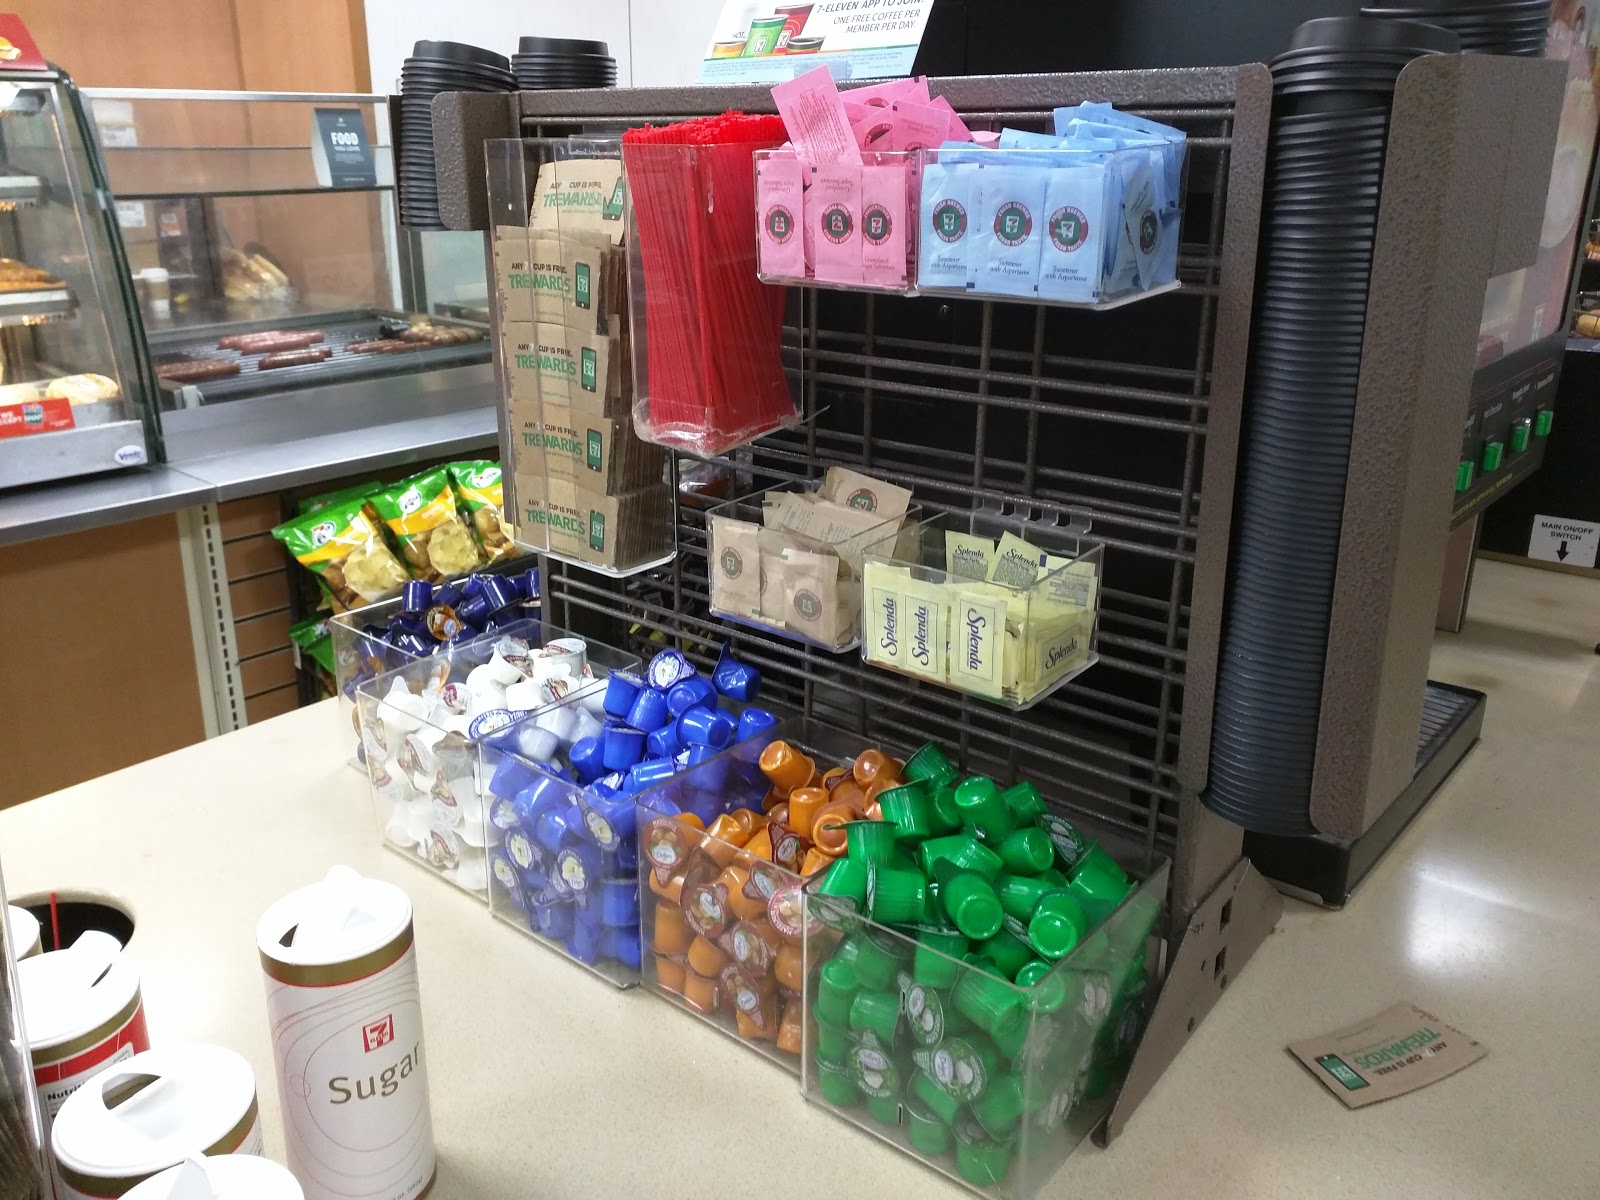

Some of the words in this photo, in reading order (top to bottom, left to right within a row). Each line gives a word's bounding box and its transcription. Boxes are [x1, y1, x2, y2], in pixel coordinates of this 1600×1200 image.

[816, 1, 859, 13] 7-ELEVEN
[861, 0, 880, 9] APP
[833, 16, 851, 25] ONE
[851, 13, 871, 23] FREE
[872, 10, 903, 22] COFFEE
[904, 9, 920, 18] PER
[846, 23, 880, 33] MEMBER
[881, 21, 897, 31] PER
[898, 20, 916, 30] DAY.
[330, 132, 359, 145] FOOD
[511, 262, 524, 270] ANY
[533, 263, 545, 271] CUP
[942, 263, 967, 271] Aspartam
[538, 345, 549, 353] CUP
[550, 346, 556, 354] IS
[524, 421, 536, 429] ANY
[544, 424, 556, 432] CUP
[557, 426, 563, 434] IS
[528, 499, 539, 507] ANY
[1541, 522, 1561, 530] MAIN
[1563, 525, 1594, 534] ON/OFF
[1550, 531, 1582, 540] SWITCH
[955, 545, 984, 558] Splenda
[1006, 548, 1038, 568] Splenda
[881, 597, 897, 657] Splenda
[911, 605, 929, 666] Splenda
[967, 607, 986, 671] Splenda
[1045, 637, 1078, 670] Splenda
[1430, 1041, 1447, 1053] ANY
[1406, 1054, 1422, 1064] CUP
[328, 1040, 420, 1104] Sugar
